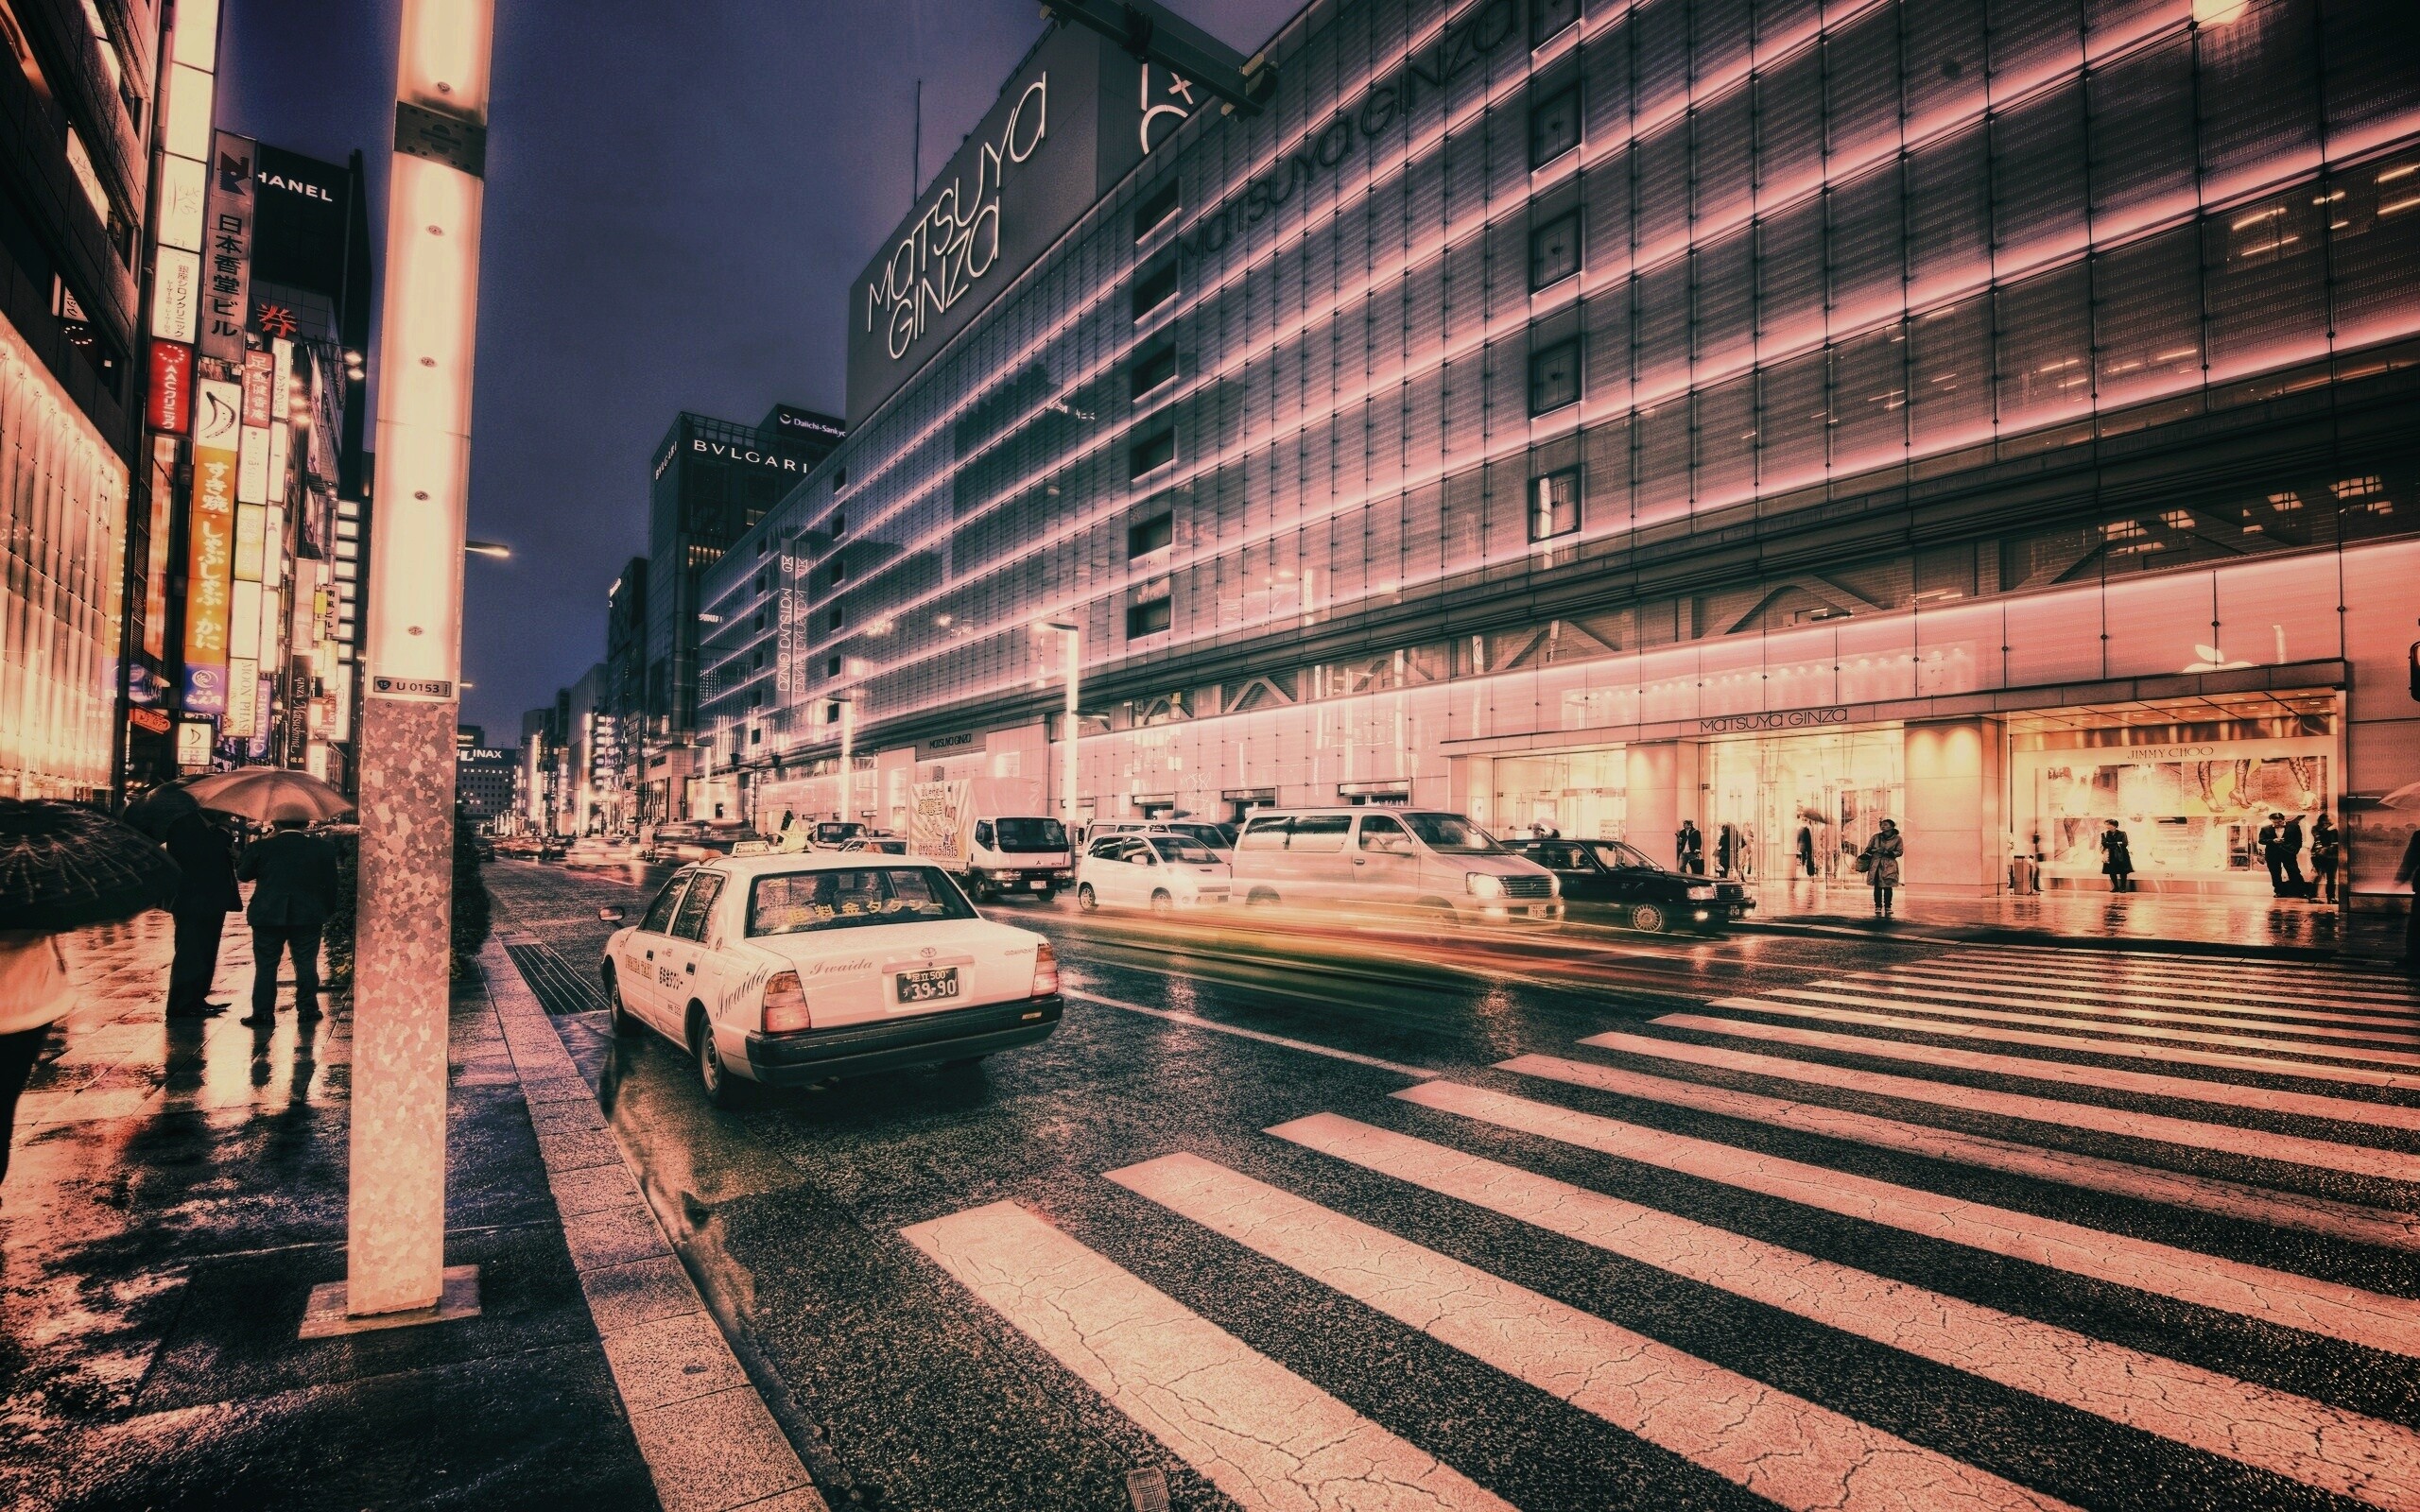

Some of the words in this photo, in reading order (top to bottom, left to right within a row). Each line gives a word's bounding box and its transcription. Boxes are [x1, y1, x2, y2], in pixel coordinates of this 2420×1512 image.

[257, 171, 334, 202] HANEL
[211, 214, 243, 338] 日本香堂ビル
[654, 440, 678, 481] BVLGARI
[693, 438, 808, 474] BVLGARI
[240, 662, 253, 696] MOON
[293, 677, 305, 698] GINZA
[396, 681, 406, 691] U
[409, 682, 440, 694] 0153
[238, 700, 251, 735] PHASE
[252, 686, 268, 753] CHAUMET
[473, 748, 502, 759] INAX
[2127, 748, 2167, 760] JIMMY
[2168, 746, 2214, 758] CHOO
[787, 898, 945, 923] 低料金タクシー
[809, 957, 873, 975] Iwaida
[716, 962, 770, 1022] Iwaida
[910, 979, 957, 1001] 39-90
